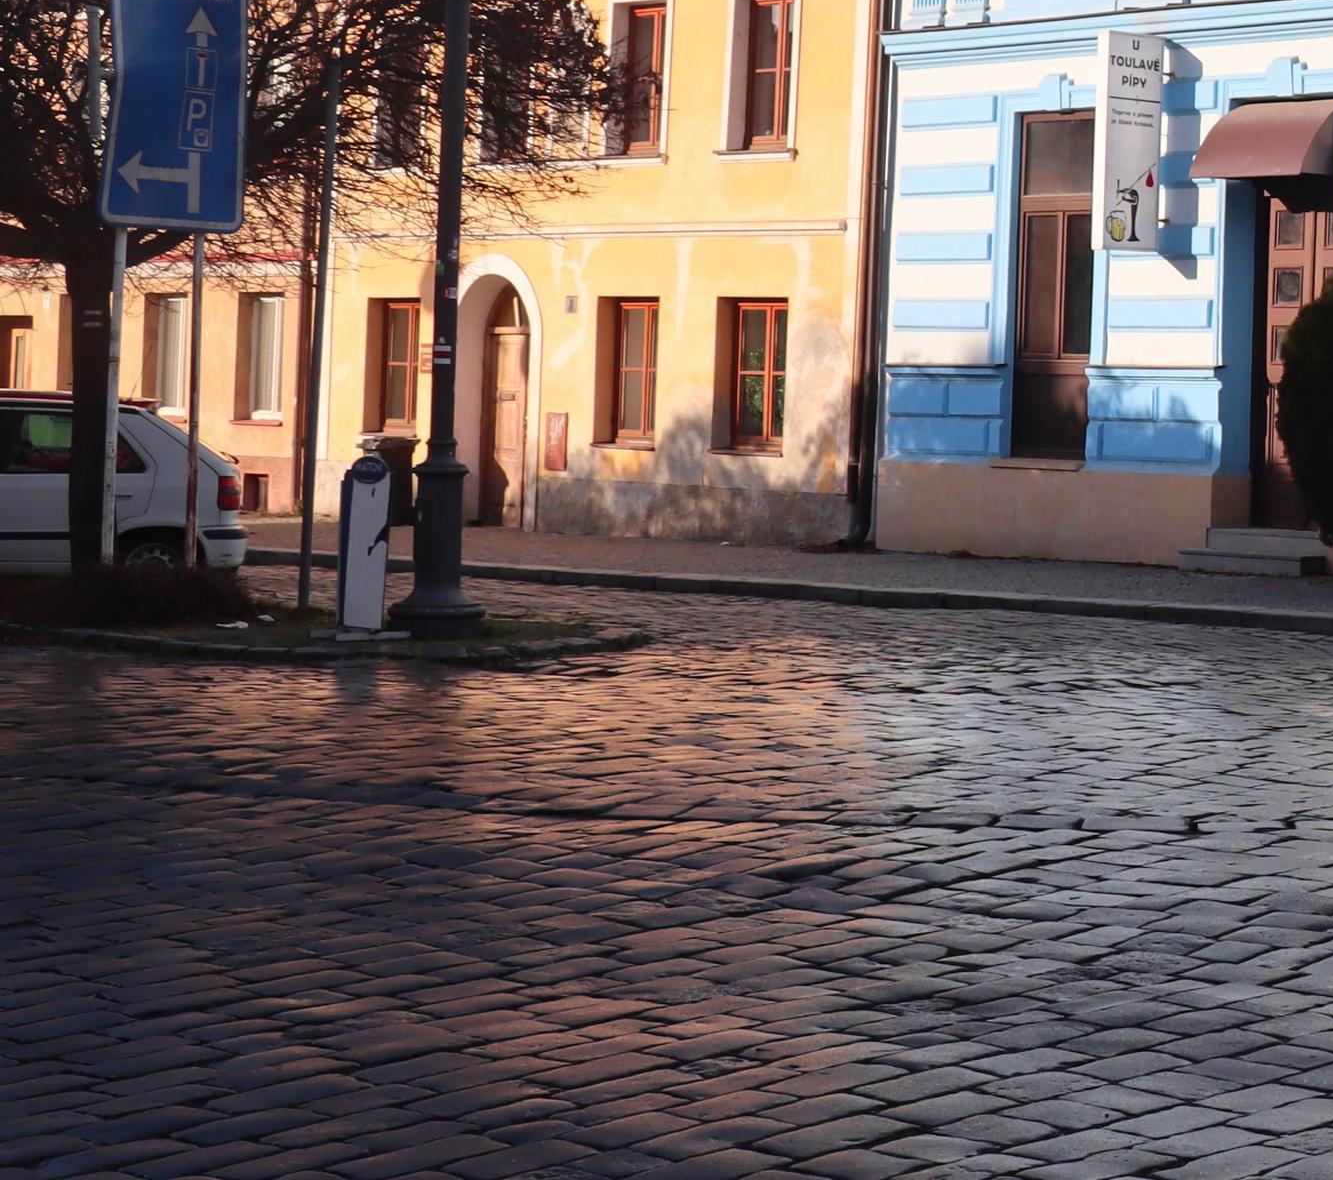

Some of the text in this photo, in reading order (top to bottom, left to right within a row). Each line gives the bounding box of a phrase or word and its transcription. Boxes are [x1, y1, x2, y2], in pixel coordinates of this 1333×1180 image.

[1132, 39, 1140, 51] U
[1110, 54, 1161, 72] TOULAVÉ
[1121, 73, 1147, 88] PÍPY
[187, 98, 207, 131] P
